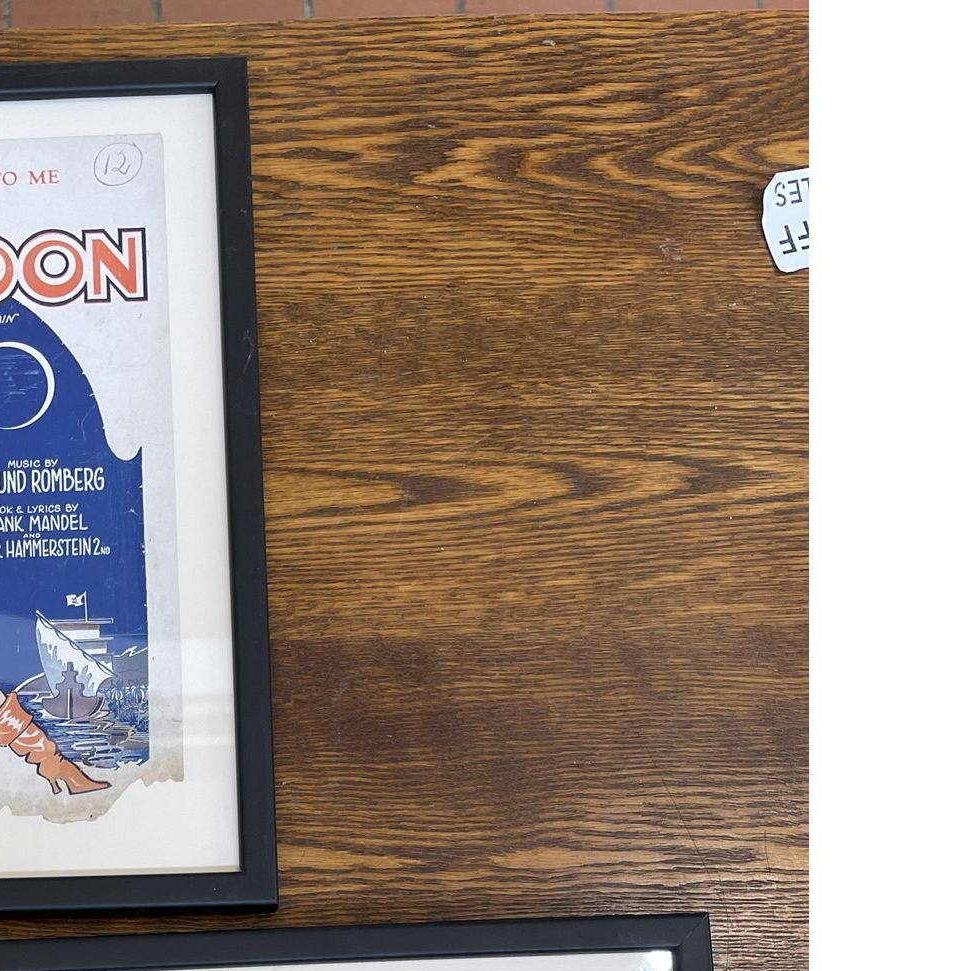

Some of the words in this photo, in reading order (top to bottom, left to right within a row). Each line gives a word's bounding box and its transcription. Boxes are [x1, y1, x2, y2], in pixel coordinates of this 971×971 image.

[103, 151, 131, 177] 12
[28, 168, 61, 185] ME
[7, 459, 41, 469] MUSIC
[44, 458, 59, 468] BY
[31, 466, 105, 493] ROMBERG
[16, 505, 24, 514] &
[27, 504, 62, 514] LYRICS
[65, 503, 79, 512] BY
[29, 513, 89, 532] MANDEL
[6, 536, 92, 559] HAMMERSTEIN
